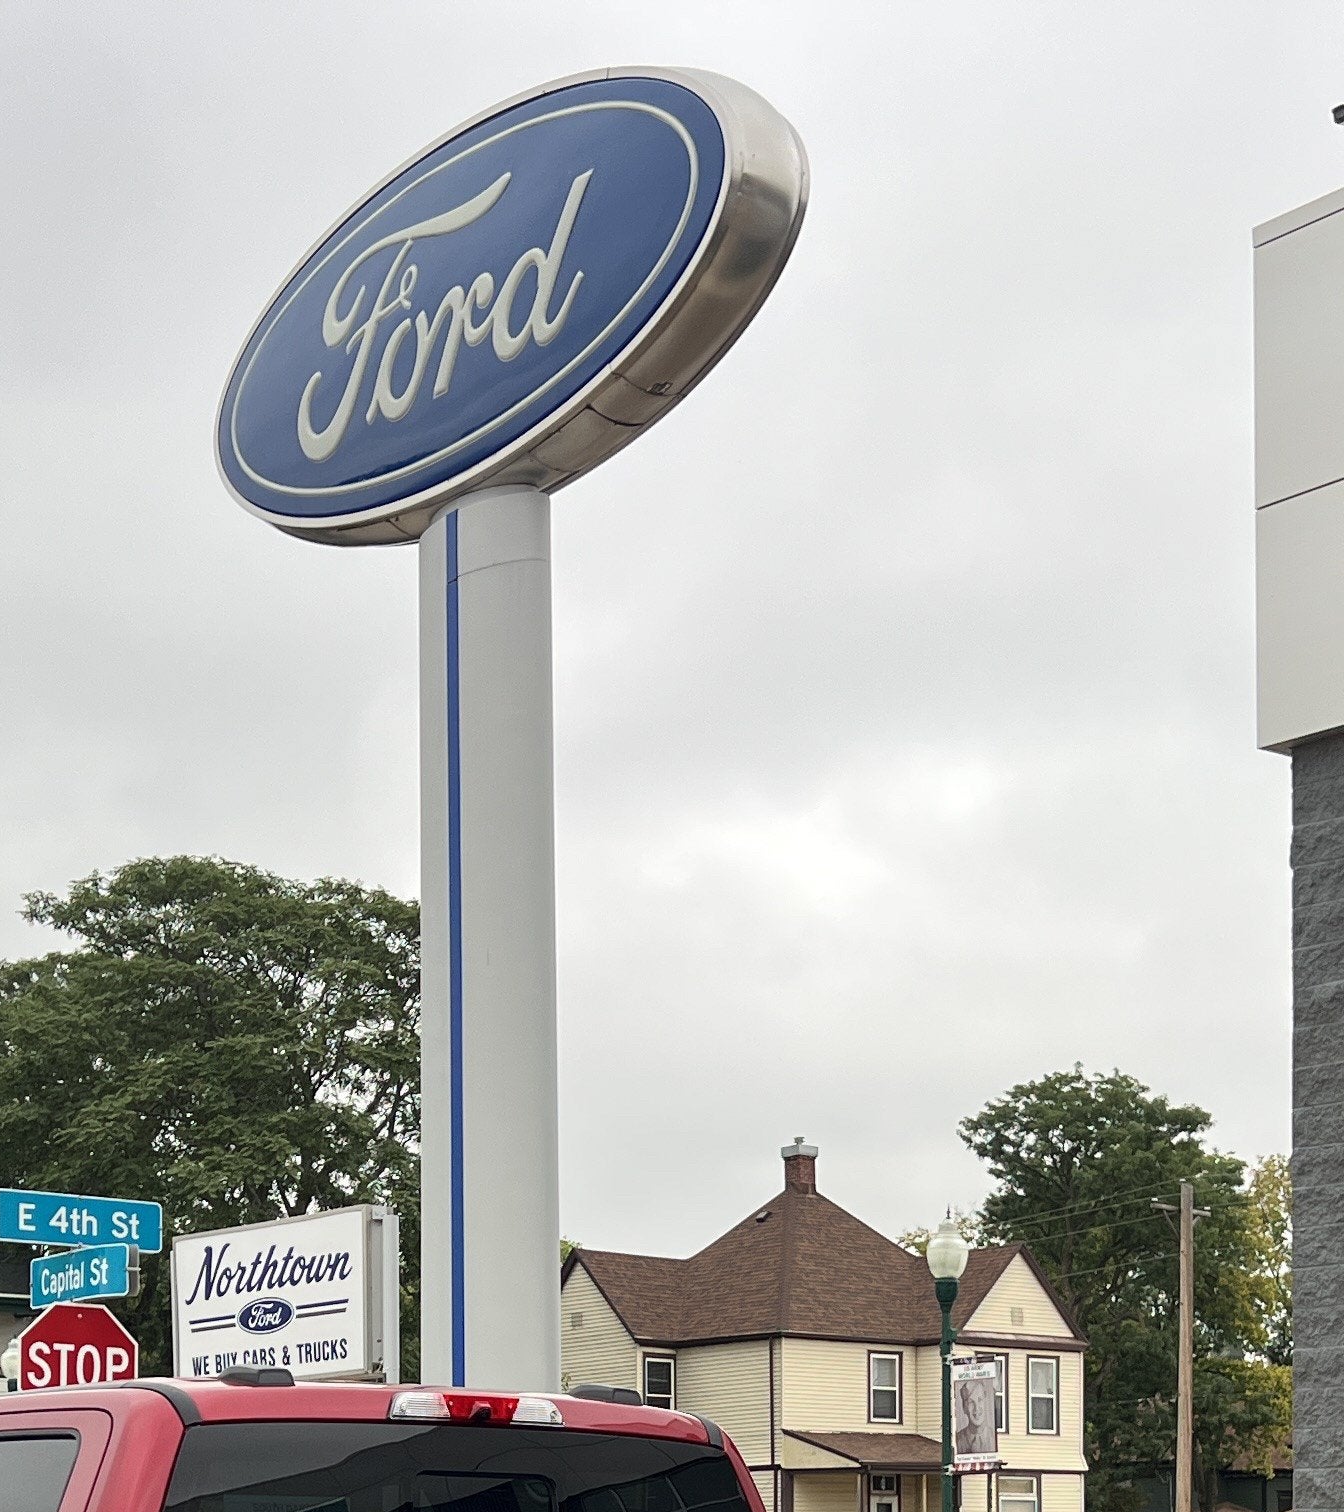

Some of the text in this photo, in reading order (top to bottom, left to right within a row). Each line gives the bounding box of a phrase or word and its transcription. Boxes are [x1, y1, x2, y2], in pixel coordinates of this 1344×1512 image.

[297, 167, 595, 463] Ford
[18, 1202, 140, 1240] E 4th St
[41, 1257, 109, 1298] Capital St
[185, 1243, 353, 1305] Northtown
[248, 1302, 283, 1328] Ford
[27, 1341, 129, 1387] STOP
[192, 1338, 348, 1377] WE BUY CARS & TRUCKS
